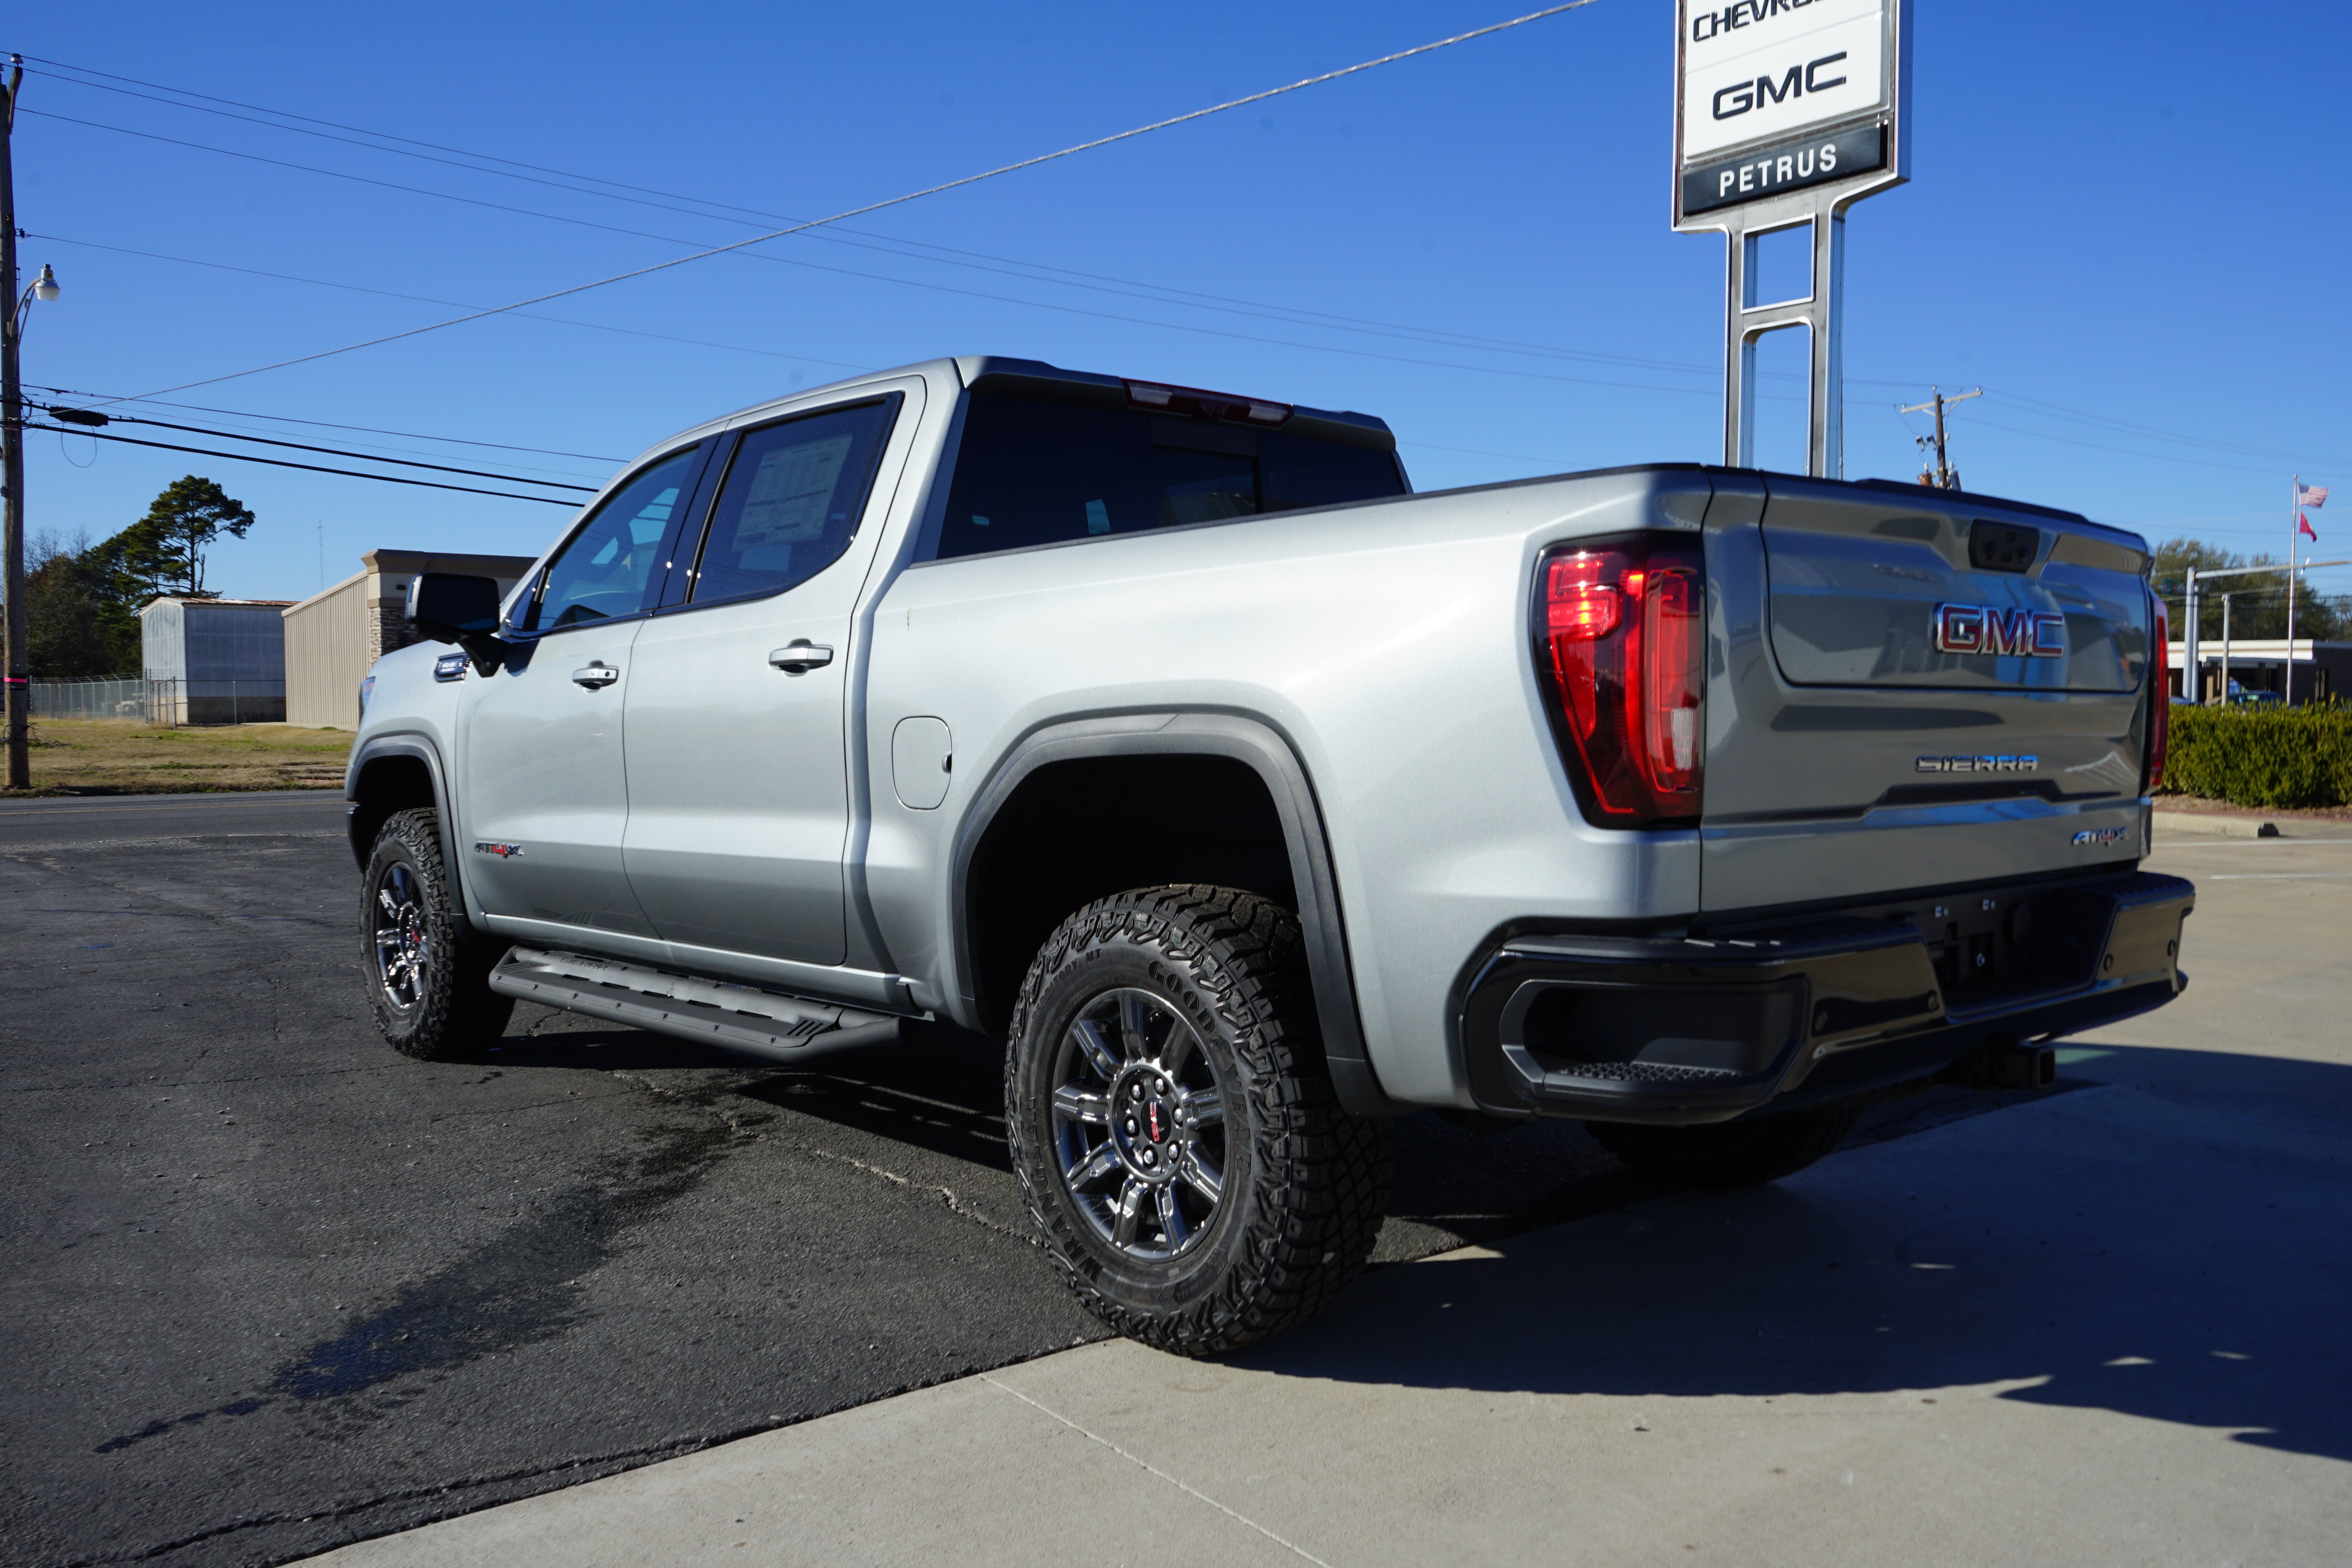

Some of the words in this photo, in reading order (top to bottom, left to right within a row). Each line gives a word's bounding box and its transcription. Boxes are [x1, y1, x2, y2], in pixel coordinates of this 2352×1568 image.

[1693, 0, 1826, 42] CHEVR
[1712, 50, 1847, 120] GMC
[1720, 144, 1837, 197] PETRUS
[1933, 603, 2063, 657] GMC
[1916, 755, 2038, 771] SIERRA
[475, 842, 524, 859] AT4X
[2071, 826, 2129, 847] AT4X
[559, 958, 608, 971] SIERRA
[1085, 948, 1102, 964] MT
[1148, 961, 1252, 1176] GOODYEAR
[1149, 1101, 1160, 1142] GMC
[1019, 1096, 1103, 1284] WRANGLER
